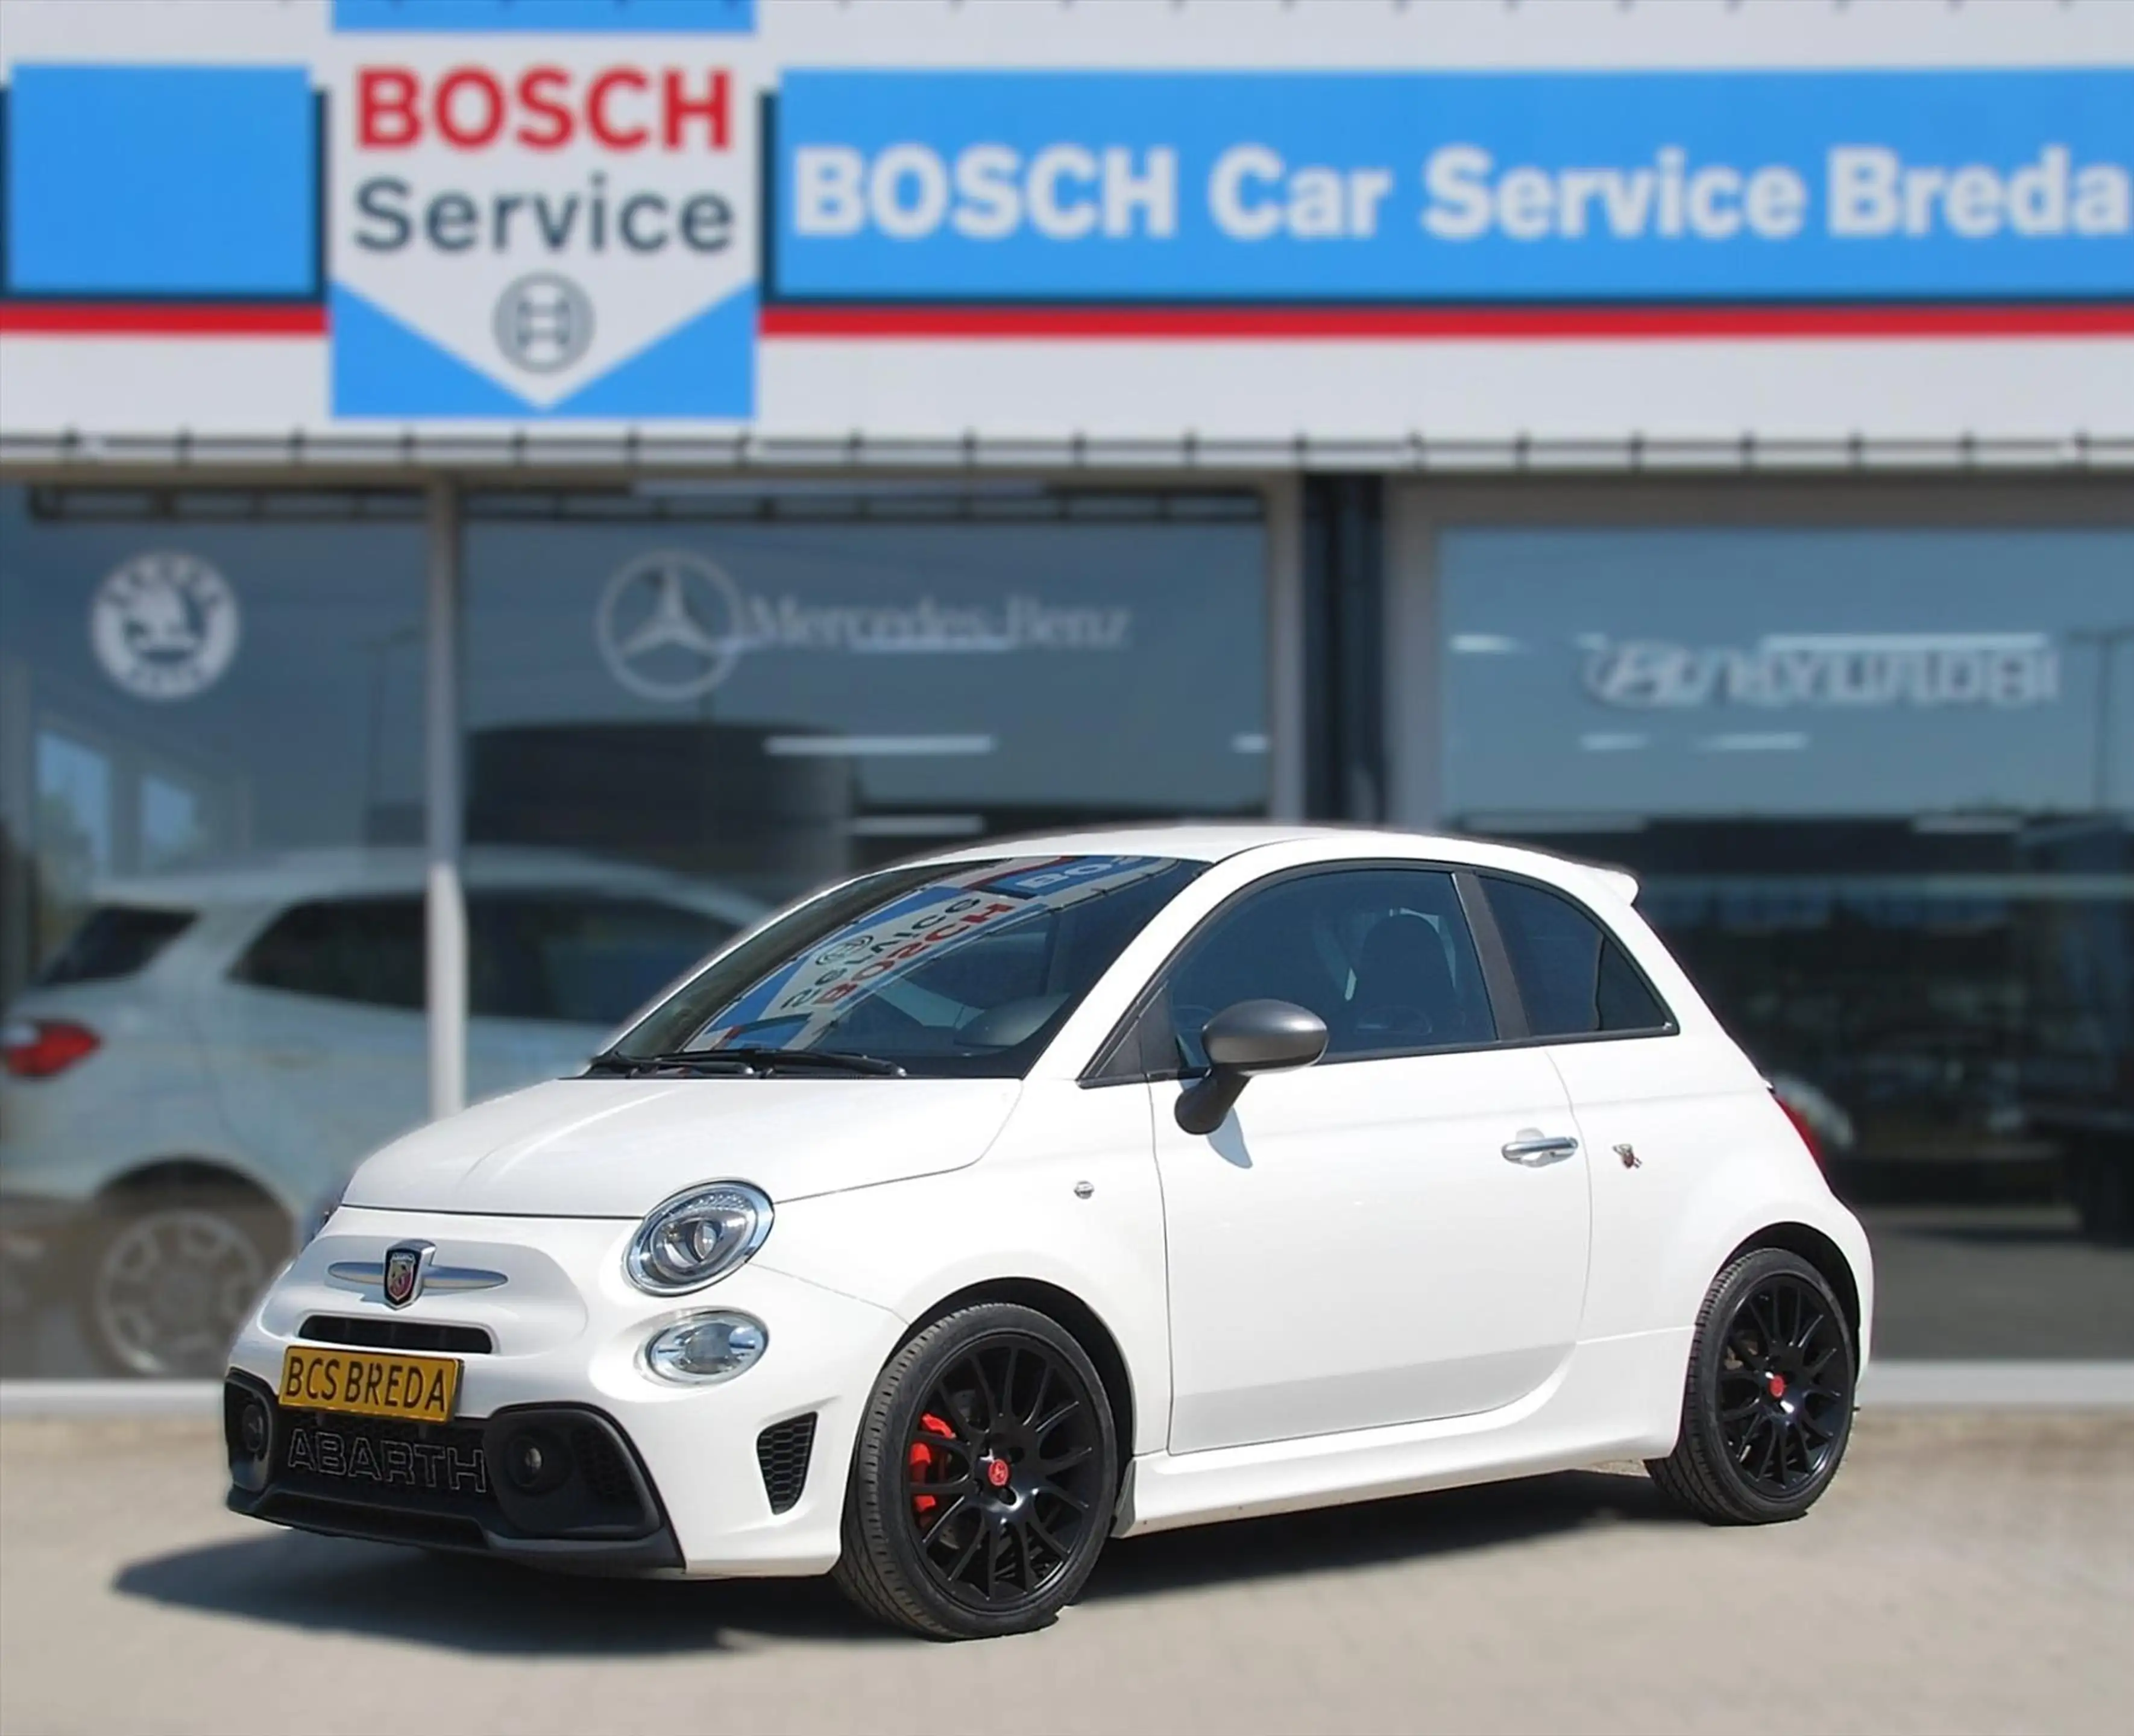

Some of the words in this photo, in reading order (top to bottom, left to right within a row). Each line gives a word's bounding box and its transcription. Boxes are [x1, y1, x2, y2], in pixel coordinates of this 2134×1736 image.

[354, 64, 732, 151] BOSCH
[353, 174, 734, 253] Service
[793, 143, 1179, 239] BOSCH
[1209, 143, 1394, 238] Car
[1420, 143, 1807, 239] Service
[1827, 143, 2130, 237] Breda
[285, 1356, 340, 1401] BCS
[344, 1360, 445, 1412] BREDA
[288, 1428, 486, 1493] ABARTH
